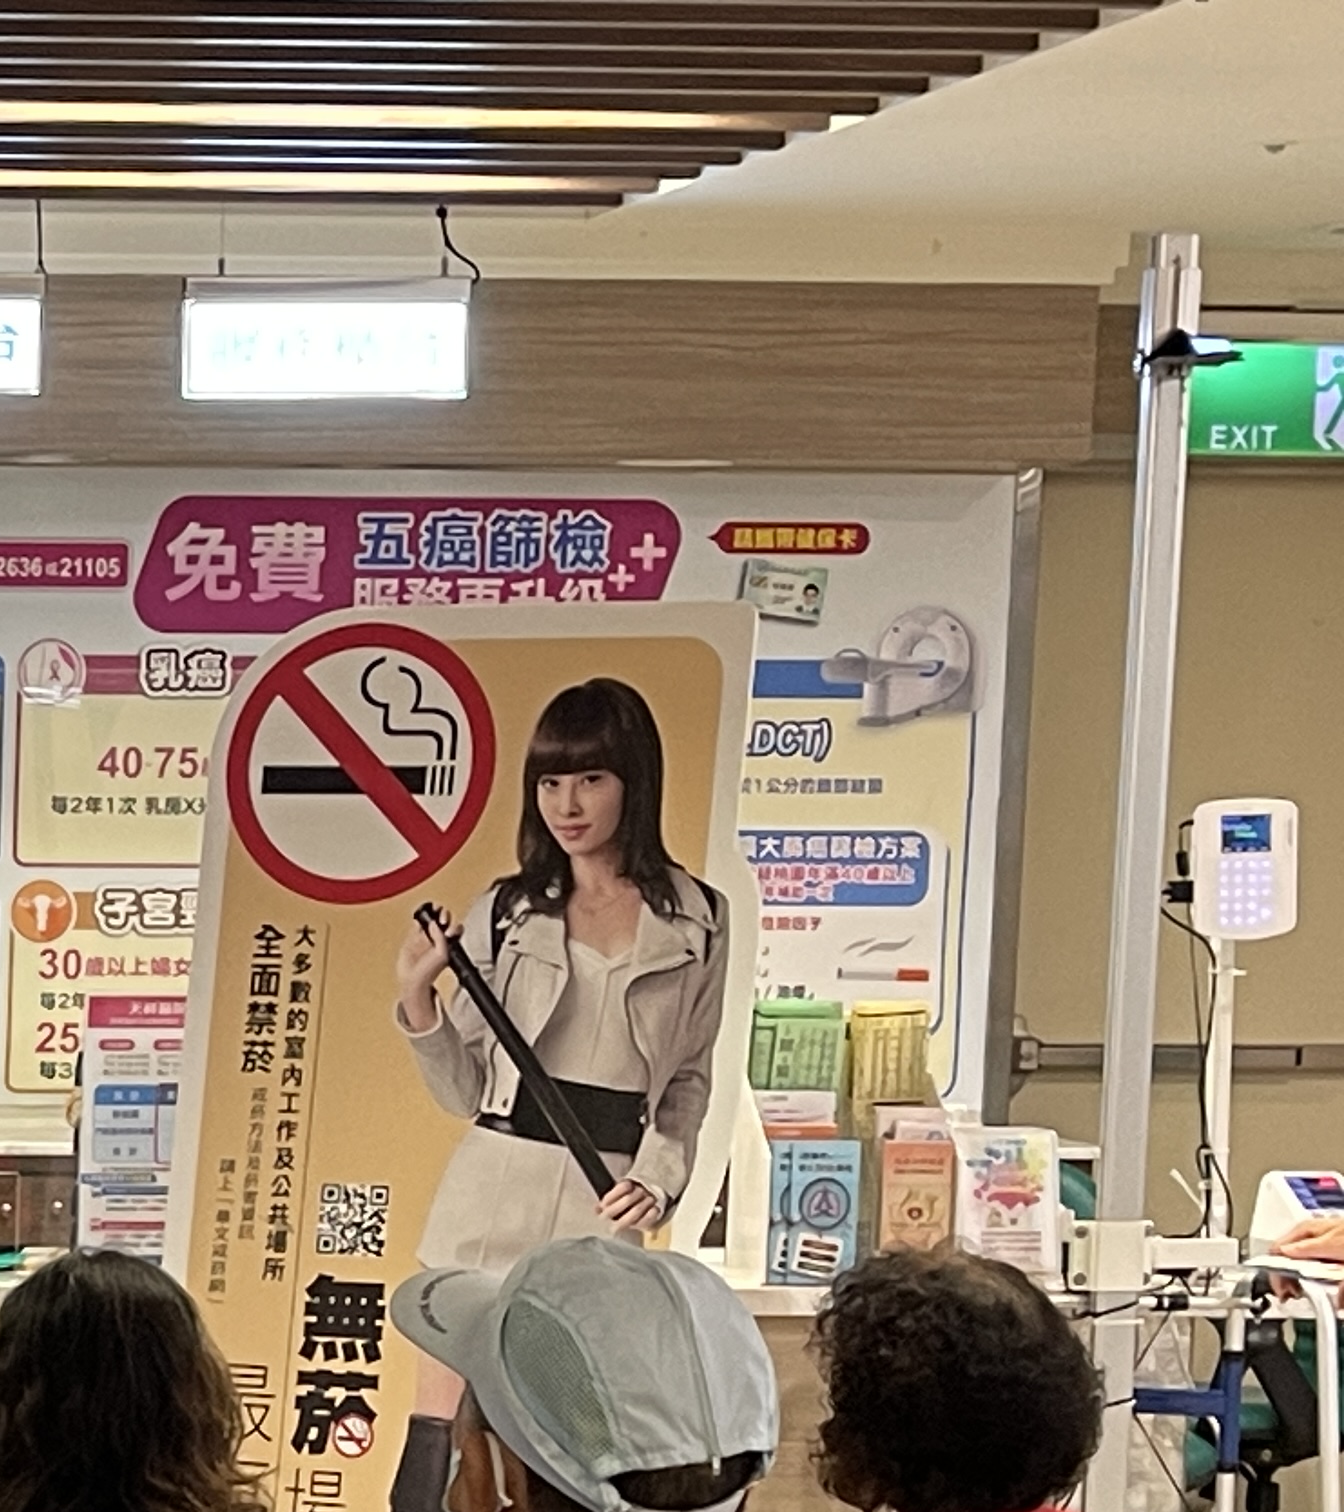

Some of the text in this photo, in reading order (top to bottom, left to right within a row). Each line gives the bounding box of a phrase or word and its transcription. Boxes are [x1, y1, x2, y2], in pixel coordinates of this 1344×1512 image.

[1209, 423, 1279, 450] EXIT
[164, 520, 327, 603] 免費
[355, 509, 611, 573] 五癌篩檢
[146, 648, 228, 691] 乳癌
[746, 719, 832, 762] DCT)
[97, 746, 208, 779] 40-75
[240, 923, 287, 1074] 全面禁菸
